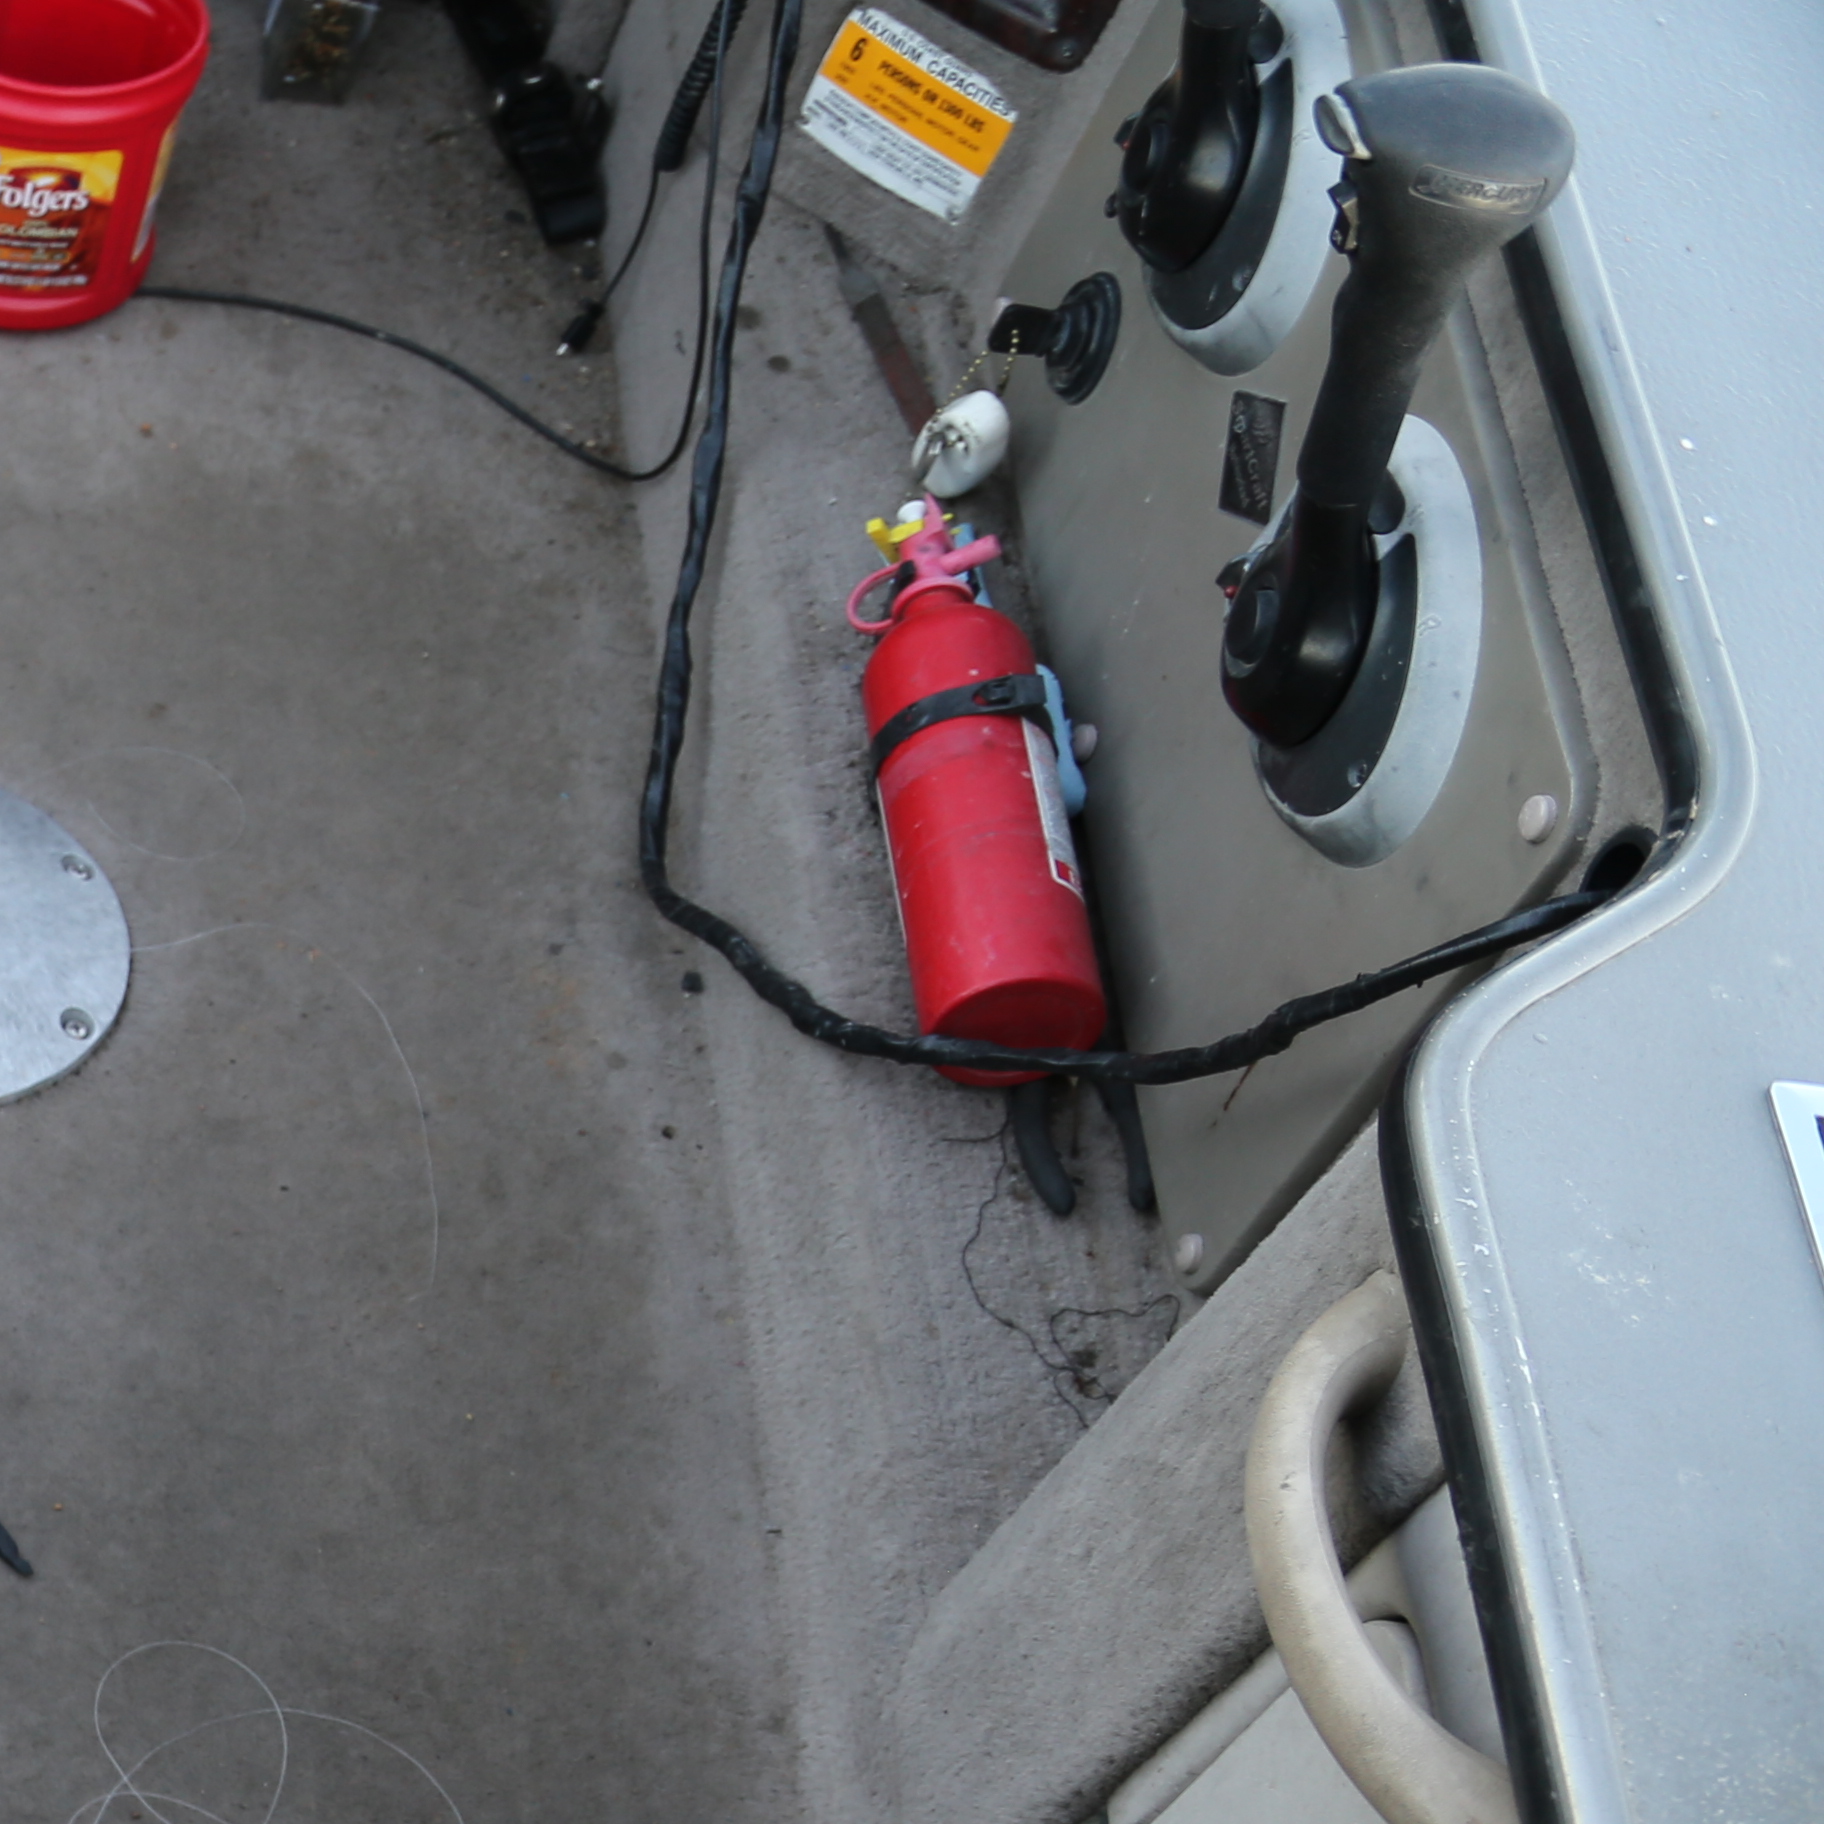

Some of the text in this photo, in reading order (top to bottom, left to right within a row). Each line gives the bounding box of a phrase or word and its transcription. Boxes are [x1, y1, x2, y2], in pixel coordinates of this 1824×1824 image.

[849, 36, 869, 62] 6
[877, 60, 922, 95] PERSONS
[857, 12, 1011, 118] MAXIMUM CAPACITIES
